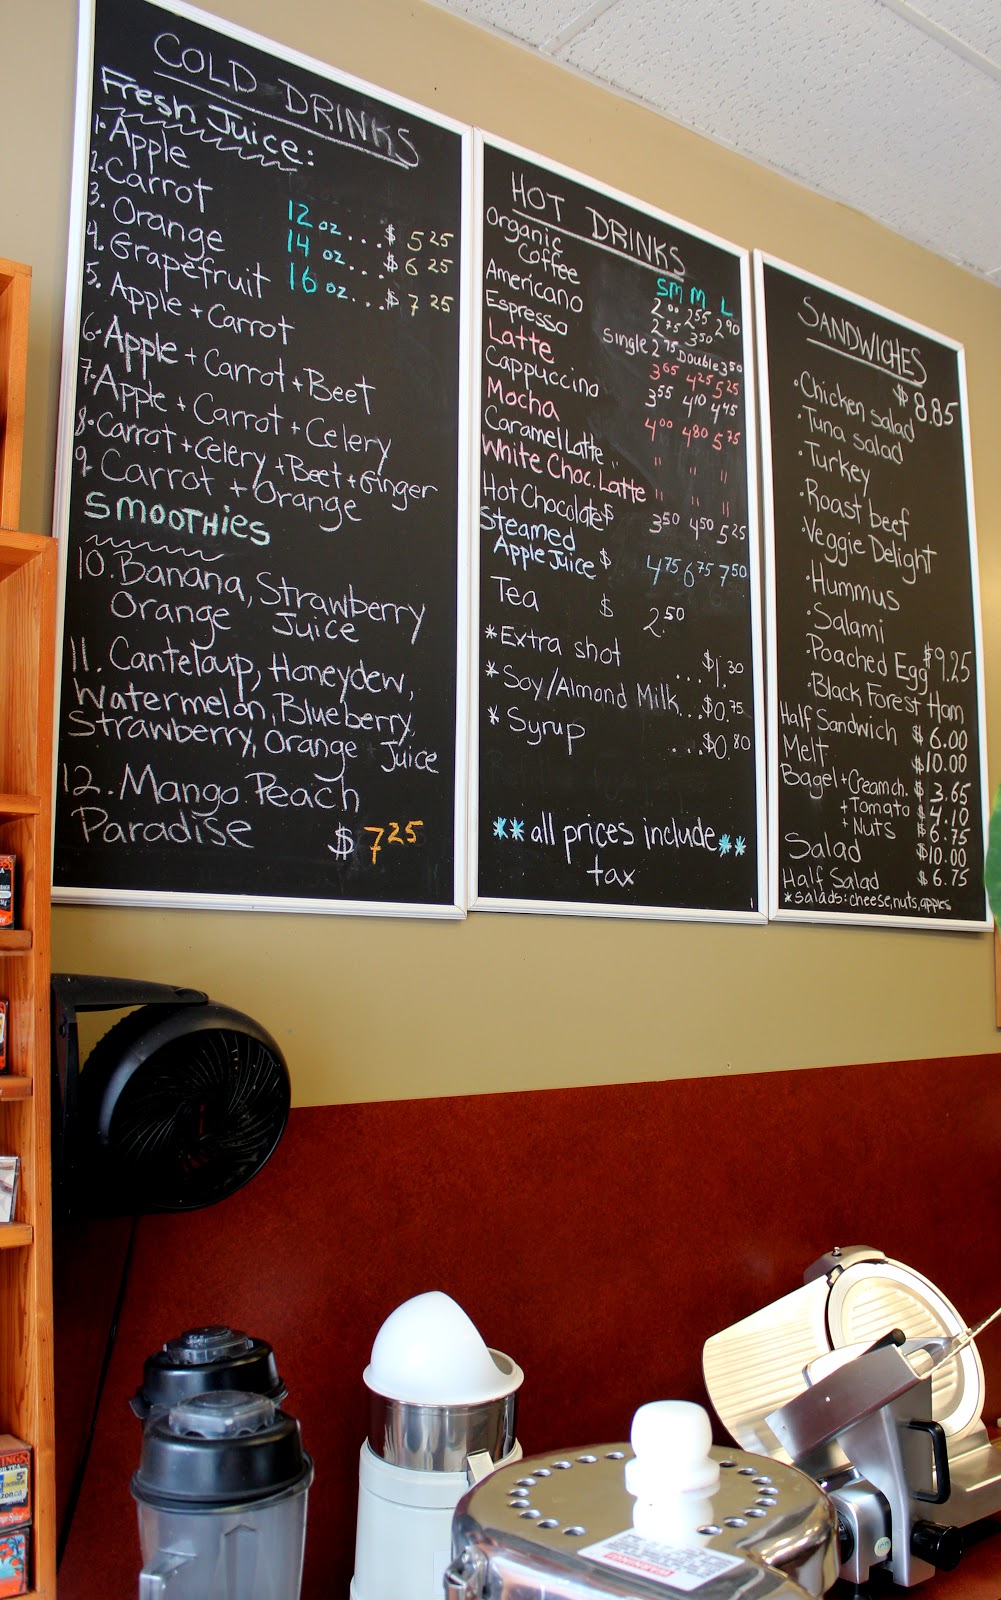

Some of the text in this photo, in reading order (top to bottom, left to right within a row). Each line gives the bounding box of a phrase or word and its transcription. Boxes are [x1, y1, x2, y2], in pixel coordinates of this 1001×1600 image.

[102, 66, 314, 166] Fresh Juice:
[154, 33, 418, 167] COLD DRINKS
[109, 117, 190, 174] Apple
[105, 157, 212, 213] Carrot
[113, 196, 225, 261] Orange
[288, 200, 313, 228] 12
[486, 206, 563, 253] Organic
[511, 171, 686, 276] HOT DRINKS
[110, 232, 271, 298] Grapefruit
[287, 229, 310, 257] 14
[518, 242, 580, 285] Coffee
[290, 262, 317, 293] 16
[486, 258, 583, 313] Americano
[110, 271, 182, 320] Apple
[208, 304, 295, 345] Carrot
[486, 289, 567, 336] Espresso
[720, 296, 733, 317] L
[103, 314, 376, 415] Apple Carrot Beet
[489, 317, 555, 364] Latte
[603, 328, 648, 355] Single
[677, 349, 719, 372] Double
[797, 296, 928, 386] SANDWICHES
[485, 345, 599, 398] Cappuccino
[93, 364, 391, 475] Apple Carrot Celery
[488, 376, 560, 422] Mocha
[801, 370, 915, 443] Chicken salad
[97, 412, 177, 453] Carrot
[485, 405, 604, 465] Caramel Latte
[802, 404, 904, 465] Tuna salad
[101, 448, 362, 532] Carrot Orange
[482, 434, 647, 504] White Choc. Latte
[804, 440, 871, 498] Turkey
[484, 470, 519, 503] Hot
[521, 483, 604, 531] Chocolate
[805, 477, 910, 542] Roast beef
[480, 505, 576, 551] Steamed
[803, 515, 938, 585] Veggie Delight
[493, 534, 545, 571] Apple
[548, 549, 596, 580] Juice
[113, 550, 252, 608] Banana,
[256, 571, 425, 645] Strawberry
[490, 575, 539, 613] Tea
[811, 559, 900, 611] Hummus
[111, 591, 359, 650] Orange Juice
[813, 602, 885, 644] Salami
[574, 635, 621, 666] shot
[806, 632, 929, 695] Poached Egg
[503, 664, 679, 714] Soy/Almond Milk
[811, 671, 964, 725] Black Forest Ham
[507, 706, 585, 755] Syrup
[779, 700, 813, 733] Half
[816, 709, 898, 746] Sandwich
[264, 730, 357, 782] Orange
[380, 740, 439, 774] Juice
[783, 734, 829, 767] Melt
[120, 763, 239, 816] Mango
[245, 772, 360, 813] Peach
[780, 763, 838, 799] Bagel
[849, 797, 910, 817] Tomato
[71, 805, 254, 848] Paradise
[531, 810, 717, 864] all prices include
[784, 832, 861, 863] Salad
[853, 817, 896, 839] Nuts
[586, 854, 636, 887] tax
[782, 866, 823, 891] Half
[830, 867, 880, 891] Salad
